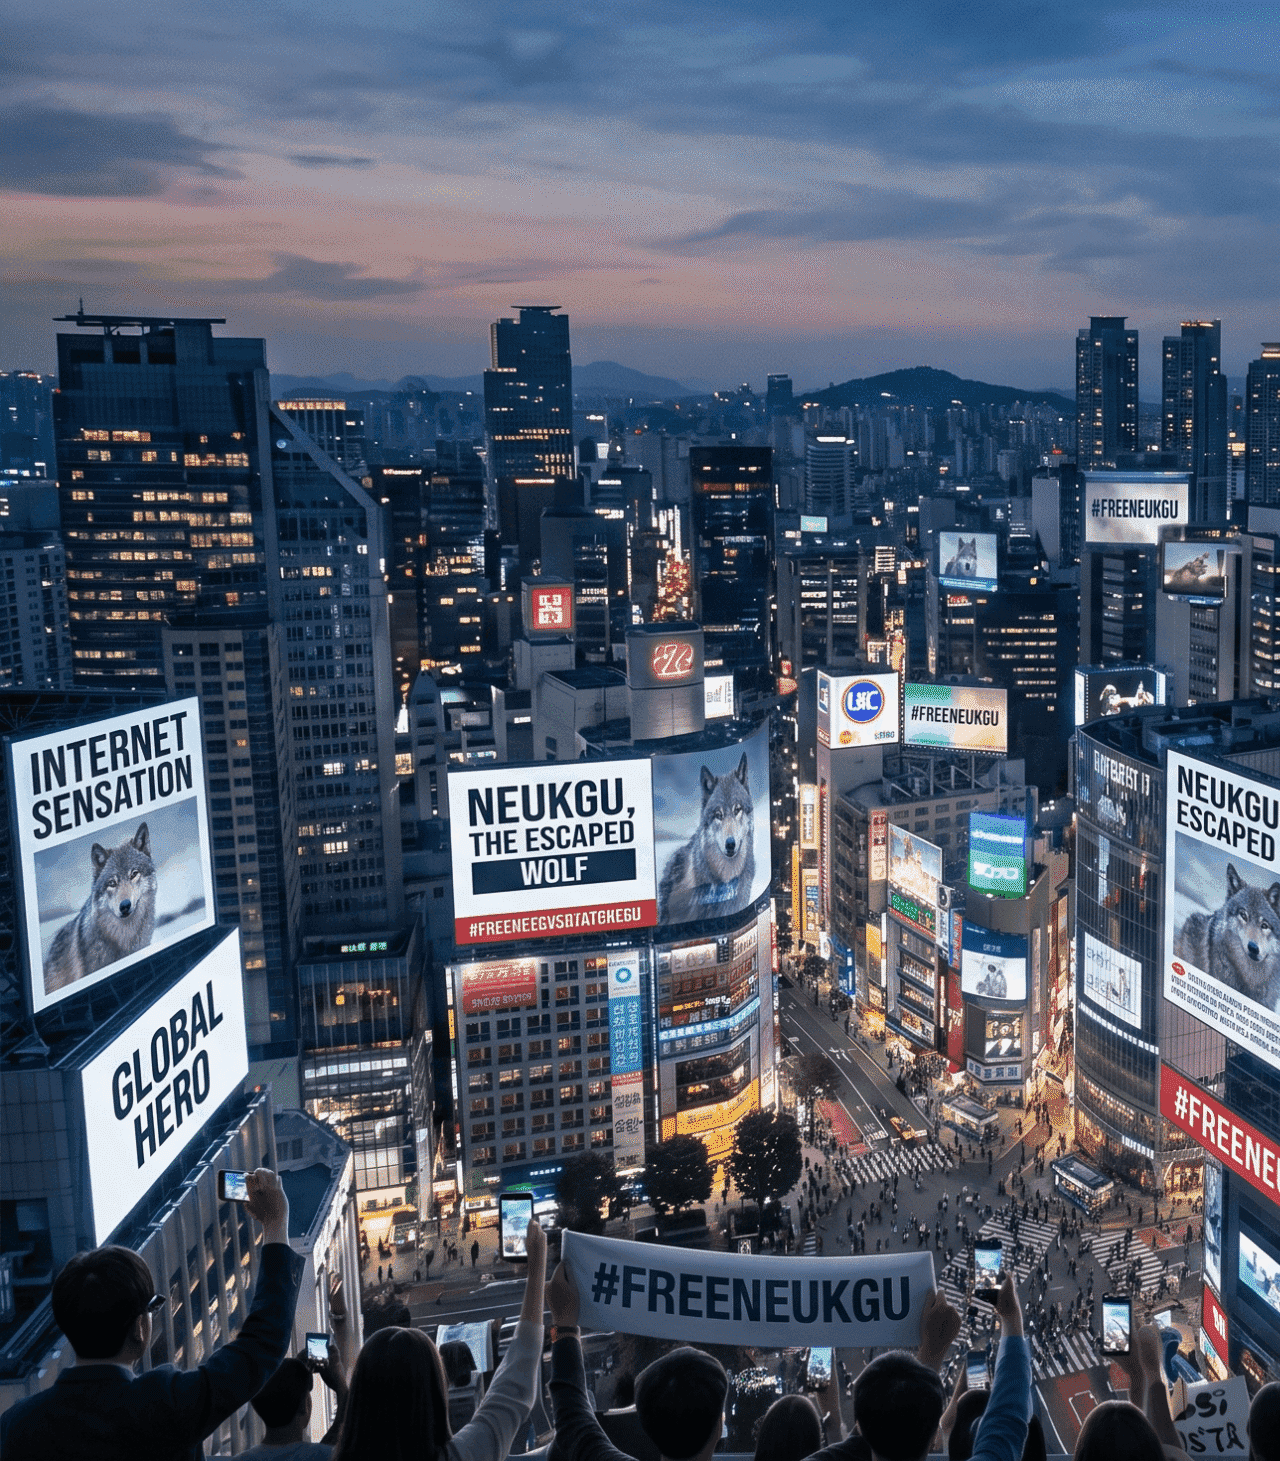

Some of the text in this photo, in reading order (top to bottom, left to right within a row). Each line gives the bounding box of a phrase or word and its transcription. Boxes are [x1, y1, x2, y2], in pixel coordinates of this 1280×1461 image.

[1091, 498, 1178, 519] #FREENEUKGU
[911, 705, 999, 726] #FREENEUKGU
[30, 711, 188, 796] INTERNET
[32, 755, 193, 840] SENSATION
[467, 777, 635, 827] NEUKGU,
[469, 820, 635, 857] THE ESCAPED
[1176, 799, 1276, 862] ESCAPED
[520, 856, 589, 886] WOLF
[111, 979, 225, 1121] GLOBAL
[134, 1048, 211, 1170] HERO
[591, 1262, 911, 1324] #FREENEUKGU
